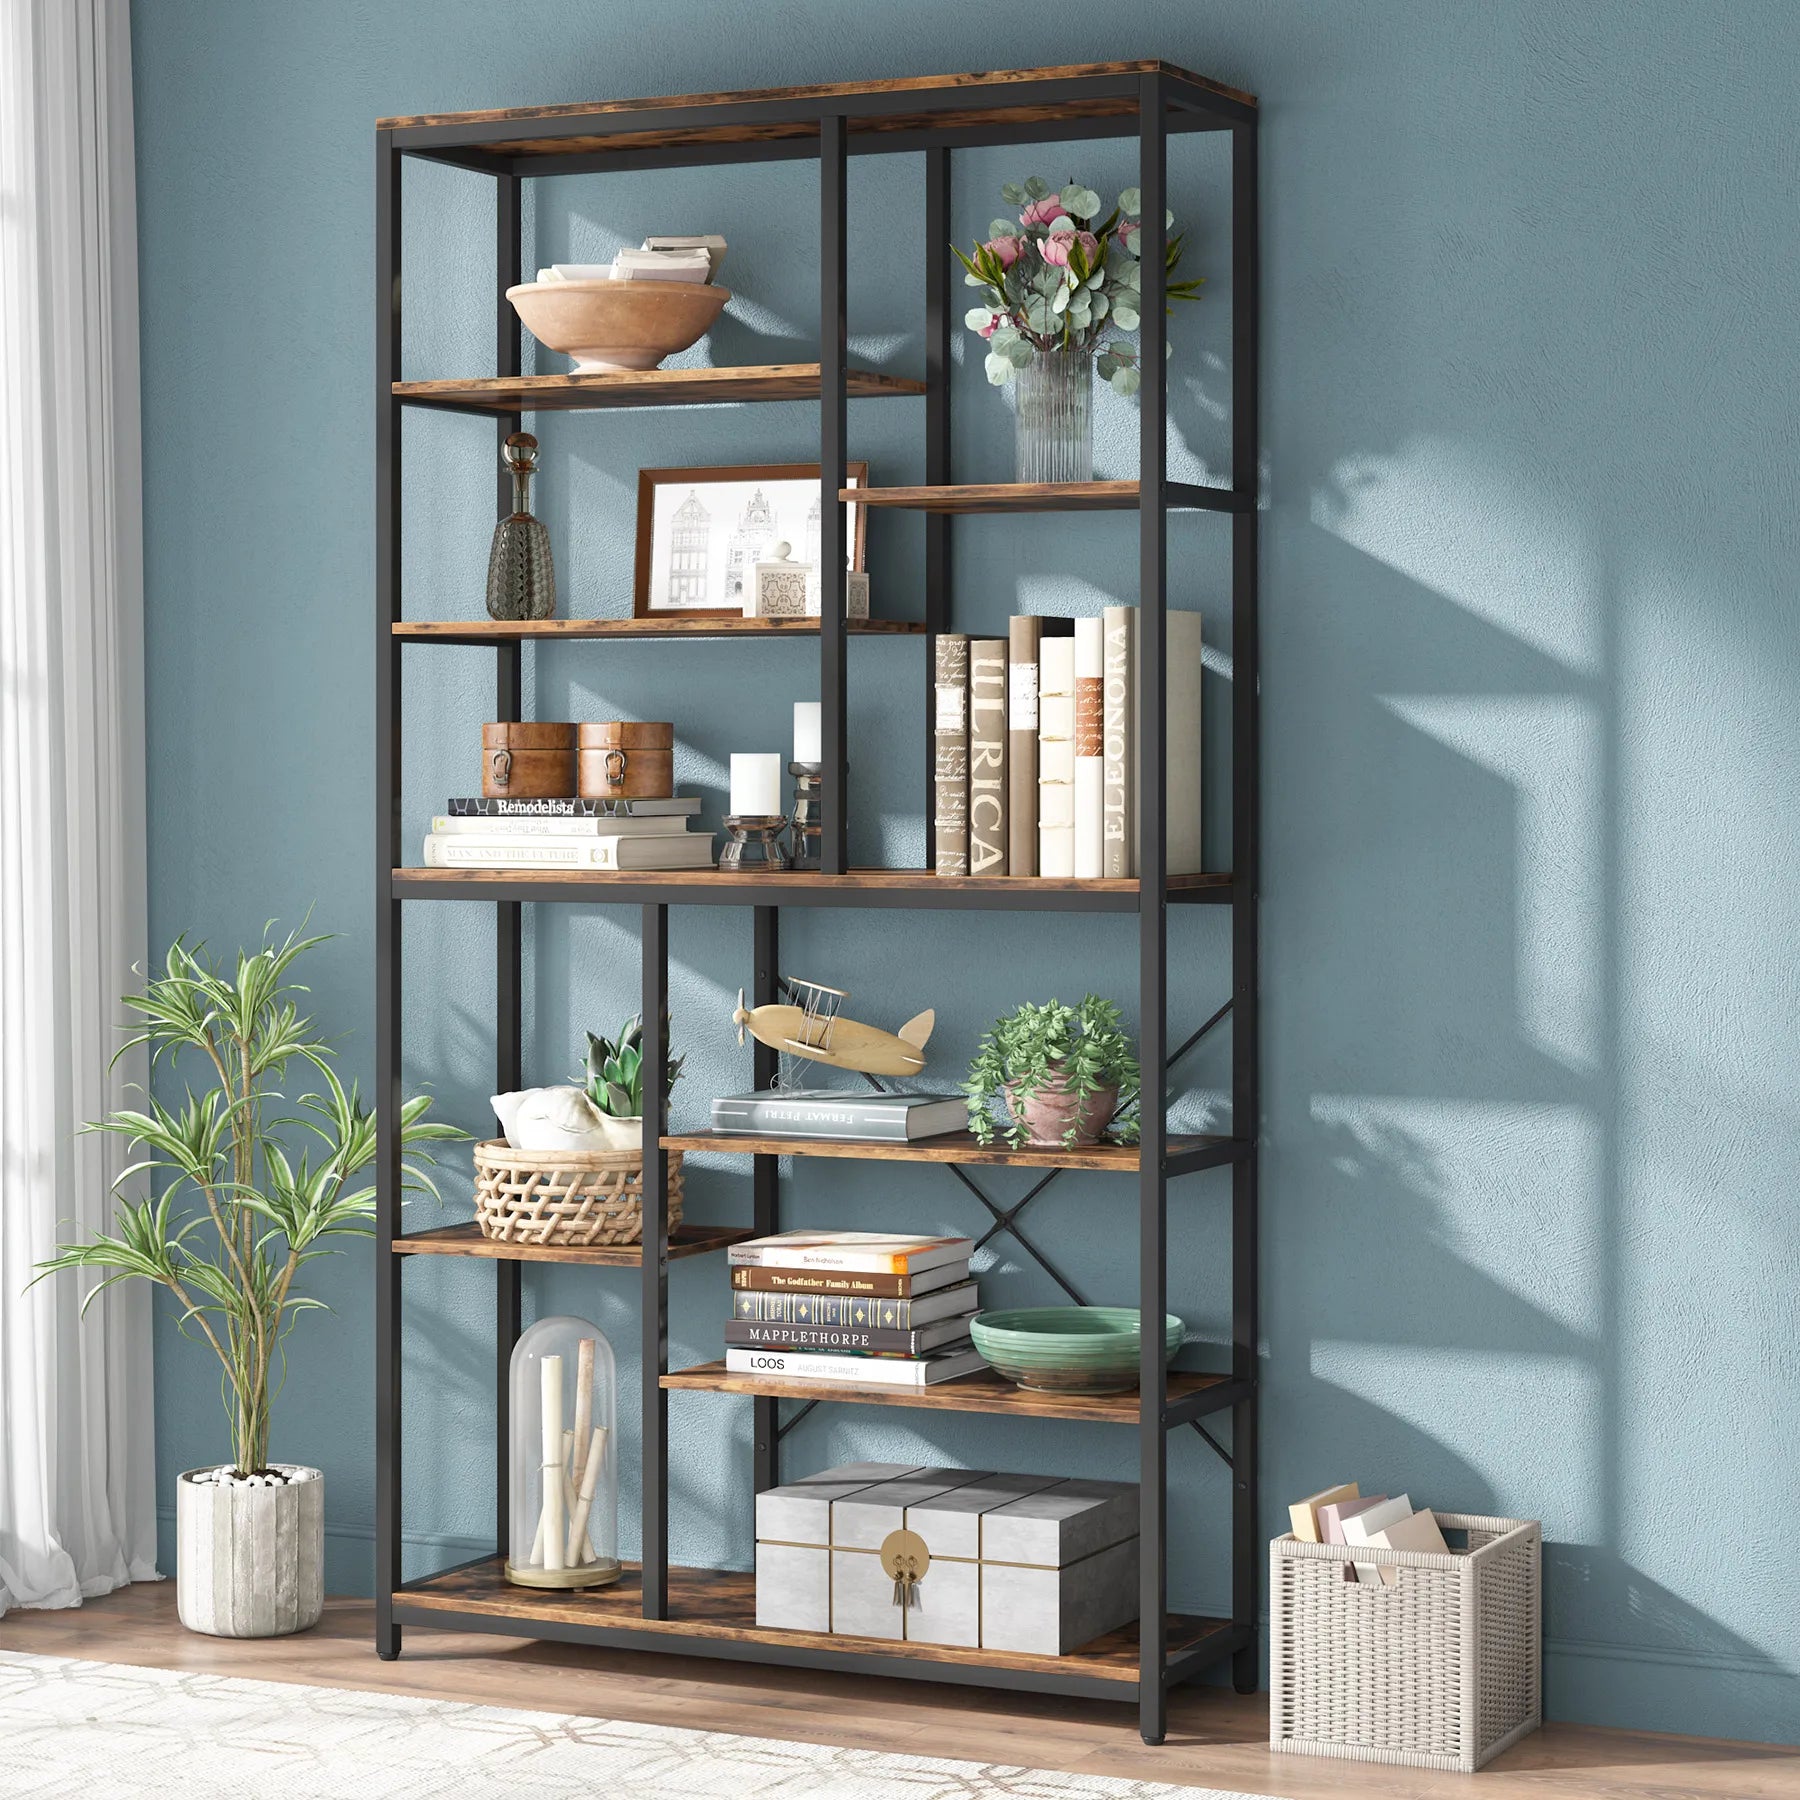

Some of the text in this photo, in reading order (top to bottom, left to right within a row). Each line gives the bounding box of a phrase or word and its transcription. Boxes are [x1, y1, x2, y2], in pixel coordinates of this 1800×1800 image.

[1105, 624, 1127, 842] ELEONORA
[971, 658, 1005, 874] ULRICA
[497, 799, 574, 814] Remodelista
[447, 850, 578, 860] MAN AND THE FUTURE
[765, 1110, 855, 1124] FERMAT PETRI
[771, 1276, 874, 1291] The Godfather Family Album
[749, 1328, 870, 1347] MAPPLETHORPE
[751, 1357, 785, 1370] LOOS
[797, 1363, 828, 1374] AUGUST
